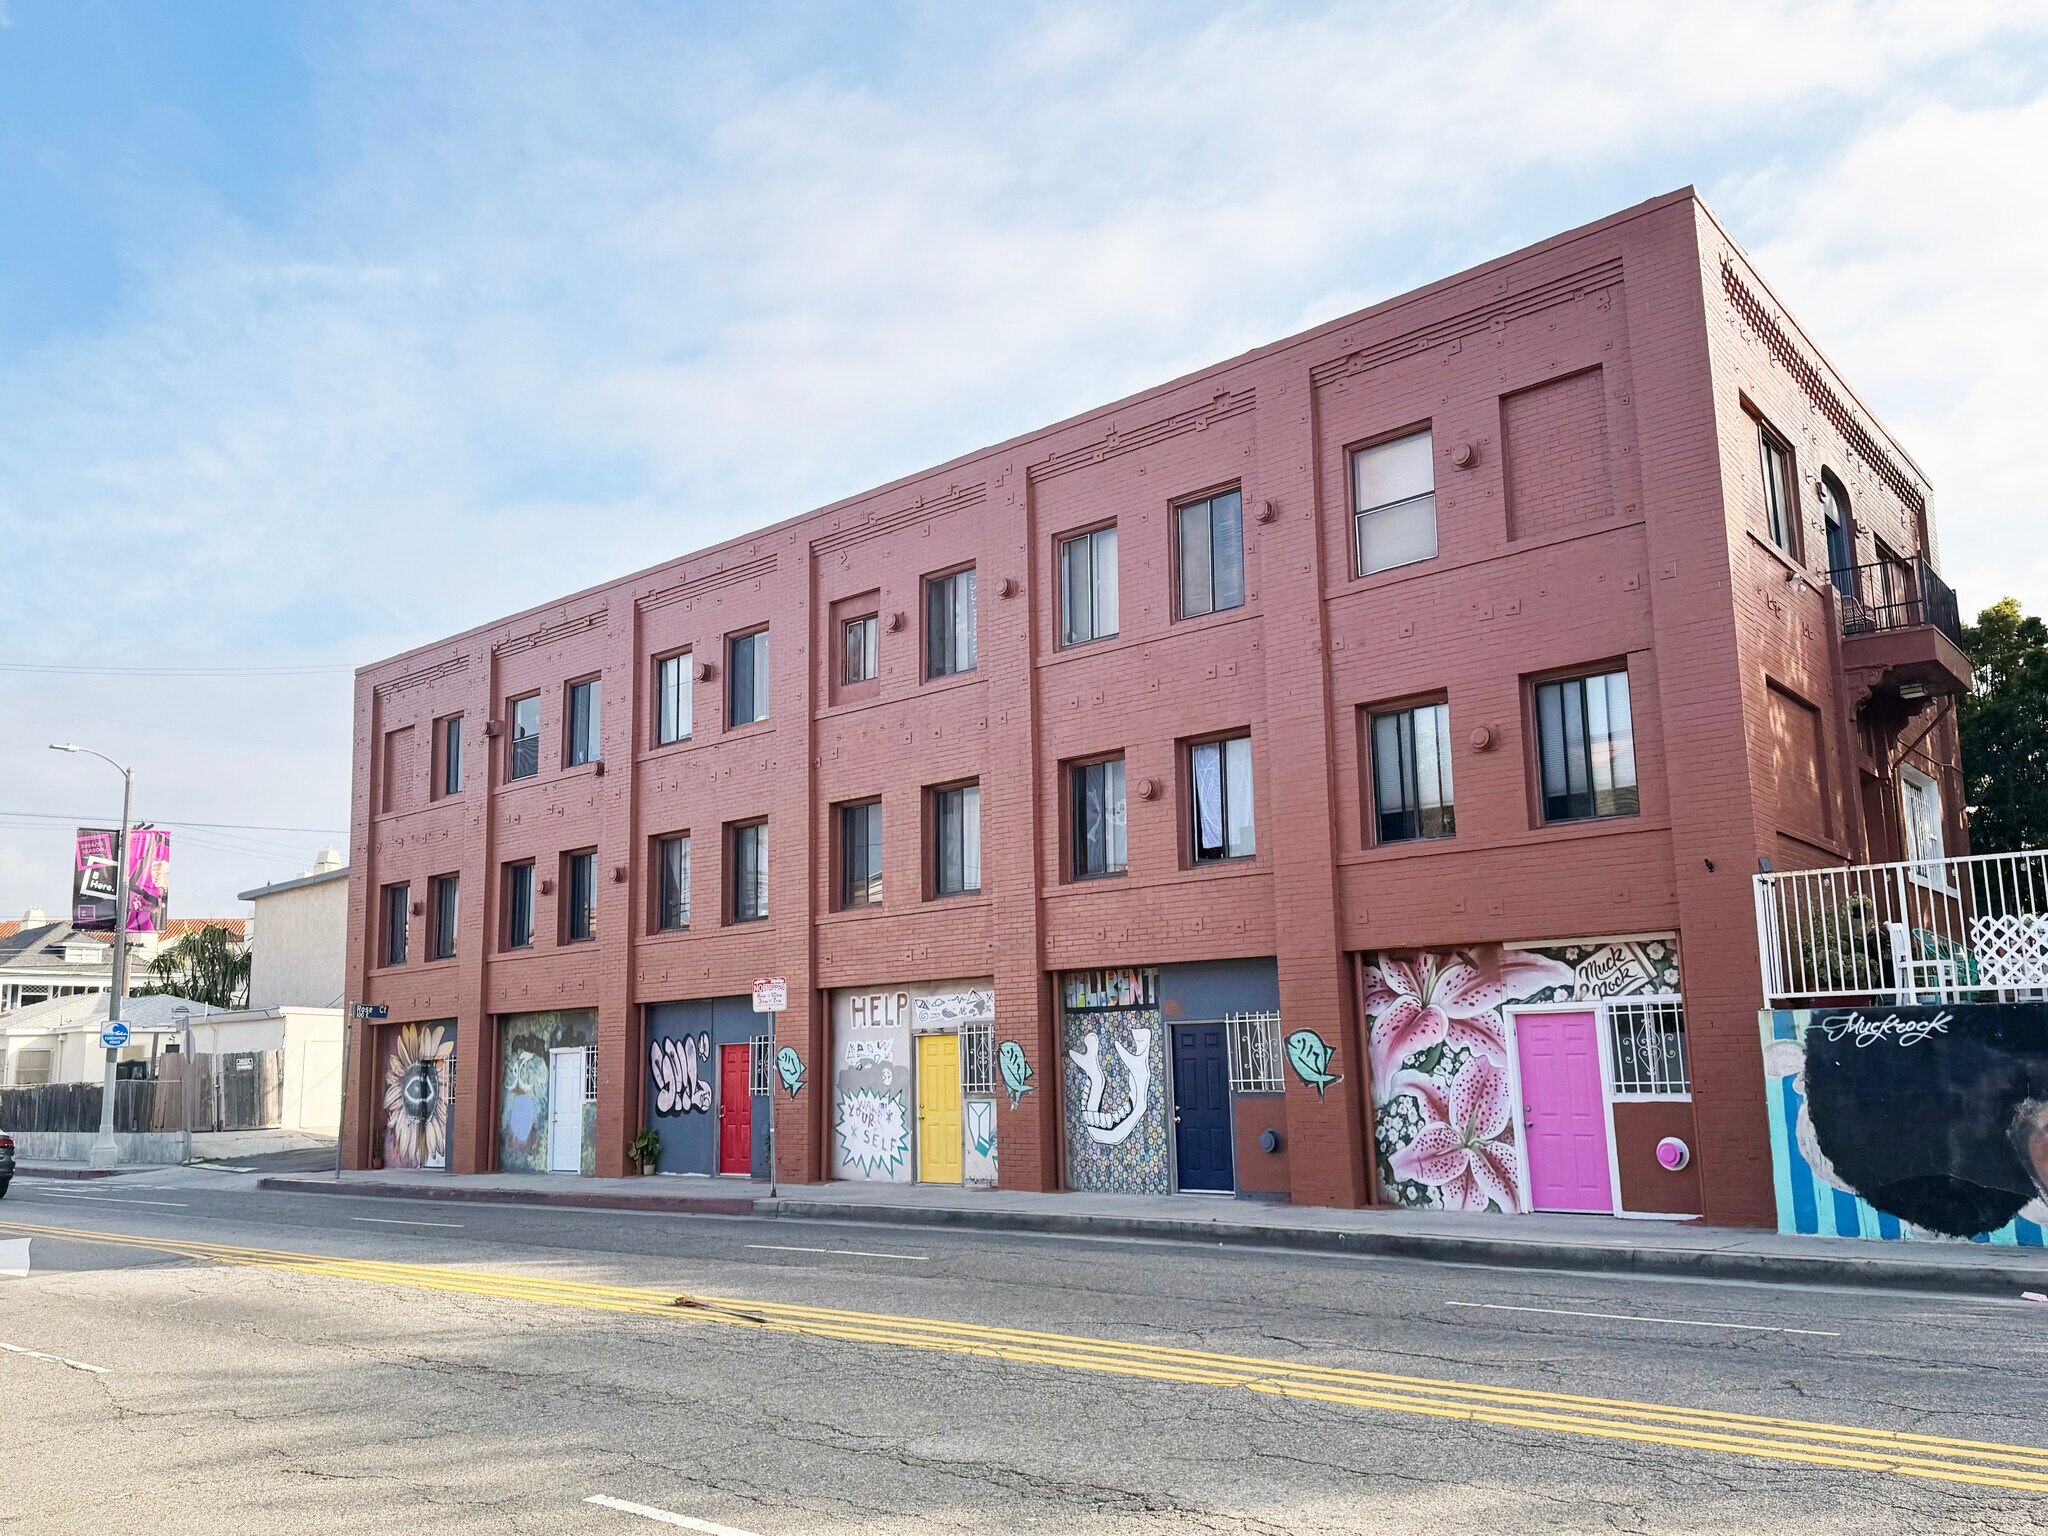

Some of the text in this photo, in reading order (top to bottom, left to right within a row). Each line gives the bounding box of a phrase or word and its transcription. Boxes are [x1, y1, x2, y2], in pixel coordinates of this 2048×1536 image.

[93, 871, 99, 879] B
[90, 880, 114, 892] Here.
[1579, 947, 1628, 983] Muck
[754, 984, 763, 992] NO
[357, 1005, 387, 1013] Rose Ct
[852, 992, 908, 1028] HELP
[1822, 1011, 1954, 1048] Muckrock
[863, 1129, 897, 1152] SELF
